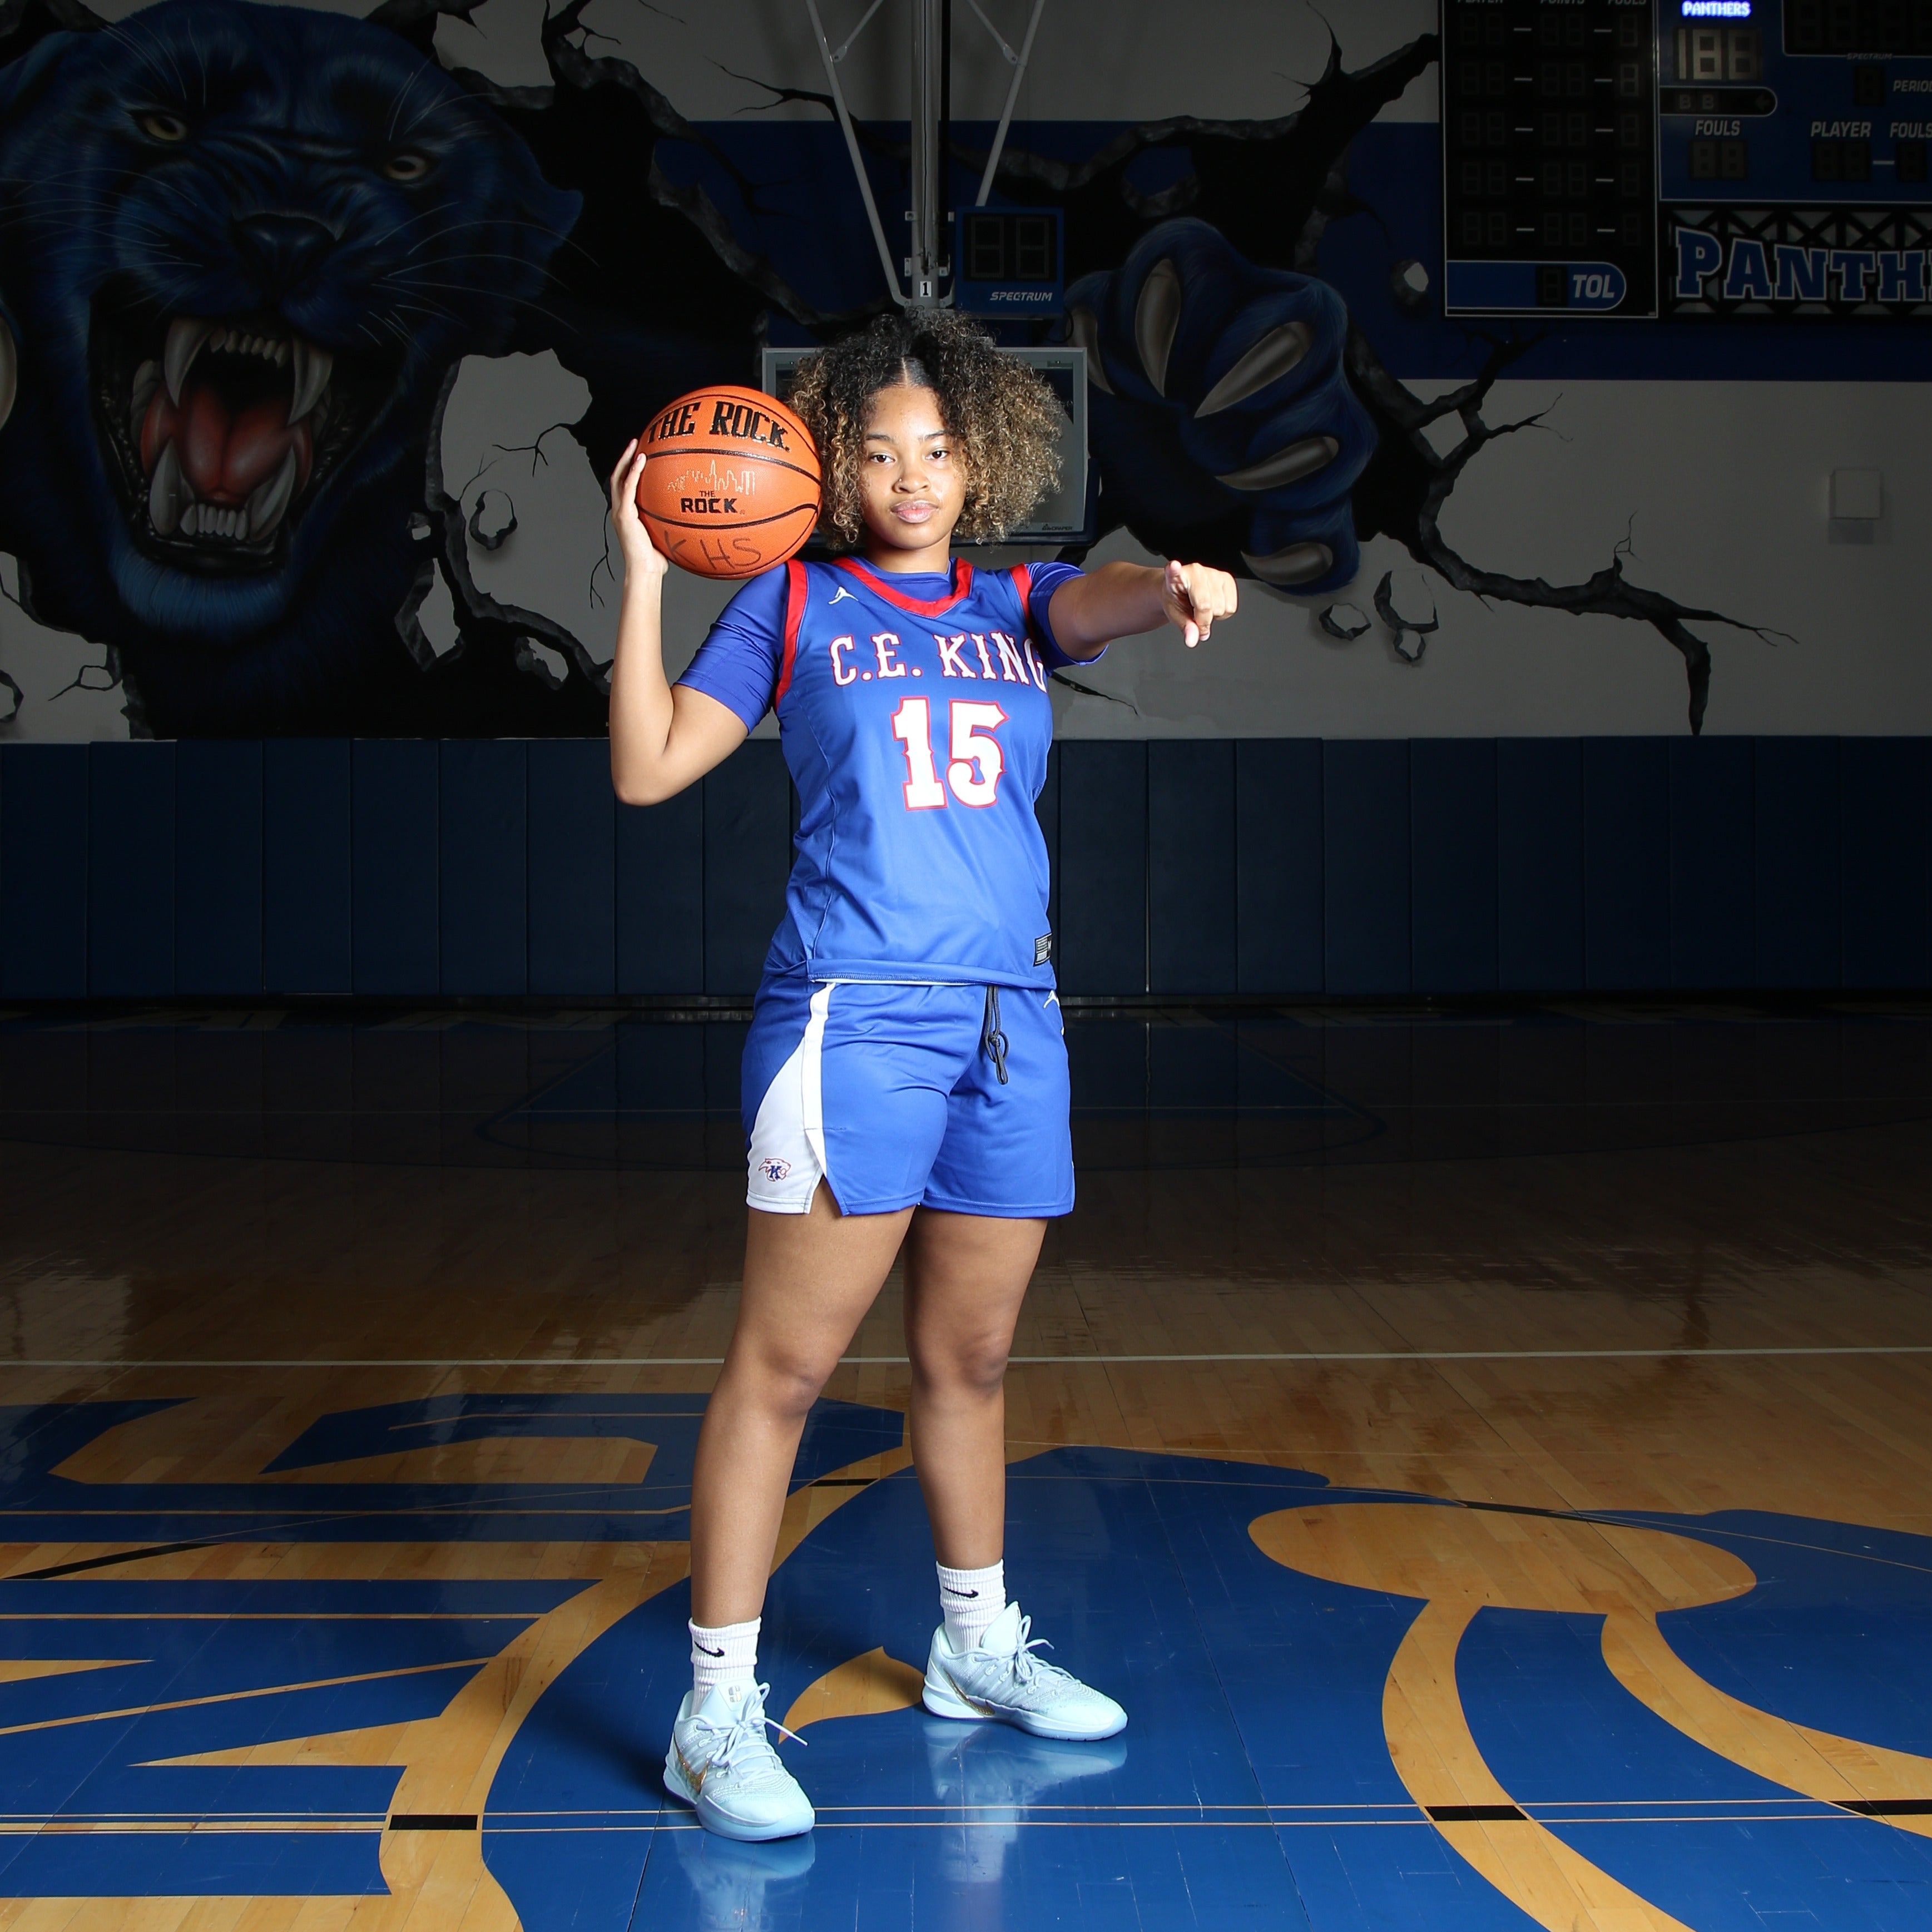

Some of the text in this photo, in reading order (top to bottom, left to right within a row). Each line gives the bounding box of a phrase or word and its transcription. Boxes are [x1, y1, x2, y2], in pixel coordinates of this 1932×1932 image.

[1681, 1, 1751, 17] PANTHERS
[1695, 120, 1740, 136] FOULS
[1811, 121, 1932, 138] PLAYER FOULS
[1675, 226, 1932, 302] PANTH
[923, 282, 929, 295] 1
[989, 291, 1053, 301] SPECTRUM
[1572, 274, 1614, 299] TOL
[648, 401, 787, 450] THE ROCK
[681, 498, 737, 513] ROCK
[665, 530, 761, 570] KHS
[829, 631, 1047, 694] C.E. KING
[890, 695, 1010, 811] 15
